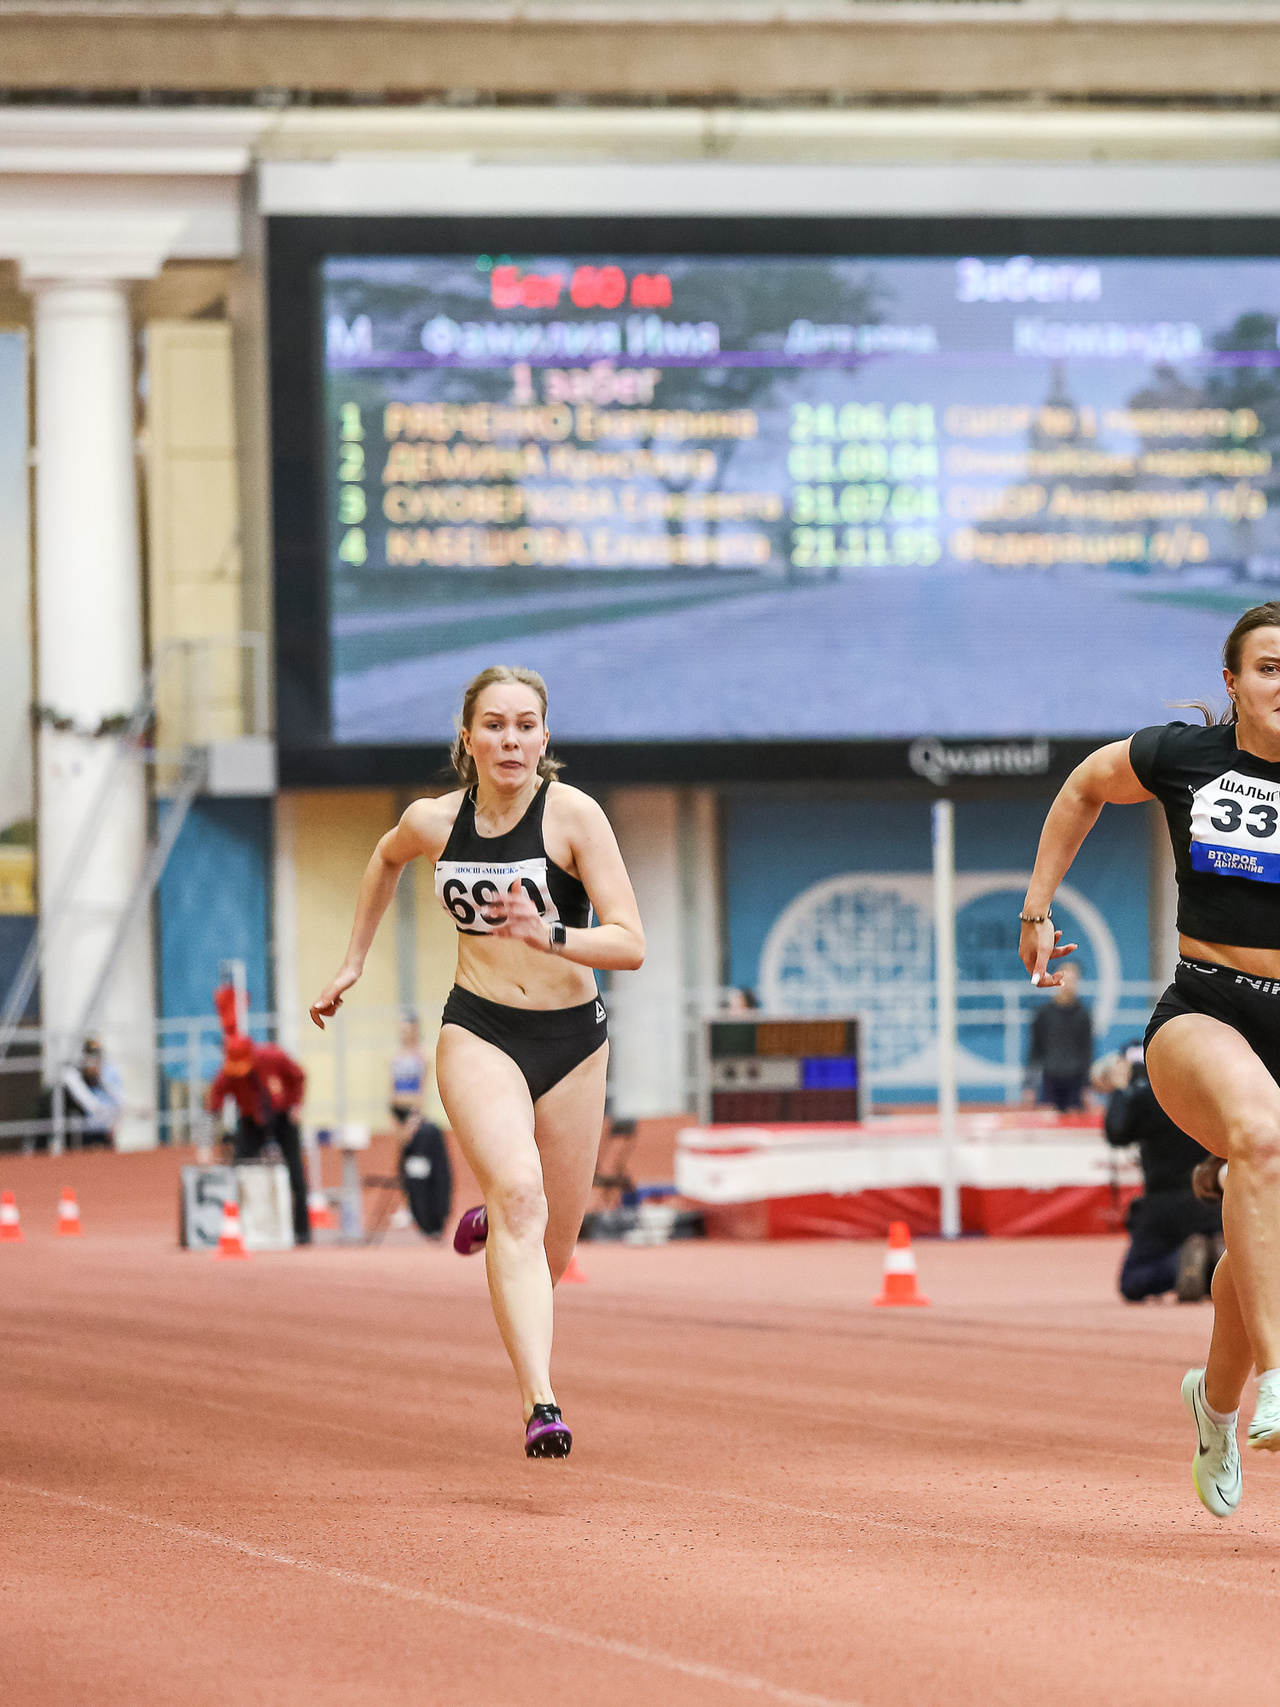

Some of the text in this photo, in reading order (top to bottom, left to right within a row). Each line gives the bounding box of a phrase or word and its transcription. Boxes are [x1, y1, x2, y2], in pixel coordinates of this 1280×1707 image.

[489, 265, 567, 309] Бег
[954, 259, 1103, 303] Забеги
[421, 315, 622, 359] Фамилия
[626, 315, 720, 359] Имя
[1015, 317, 1202, 360] Команда
[542, 362, 661, 405] забег
[338, 405, 363, 438] 1
[337, 446, 366, 480] 2
[337, 487, 366, 522] 3
[338, 530, 367, 565] 4
[909, 737, 1050, 785] Qwantel
[1207, 849, 1258, 866] ВТОРОЕ
[1213, 859, 1264, 874] ДЫХАНИЕ
